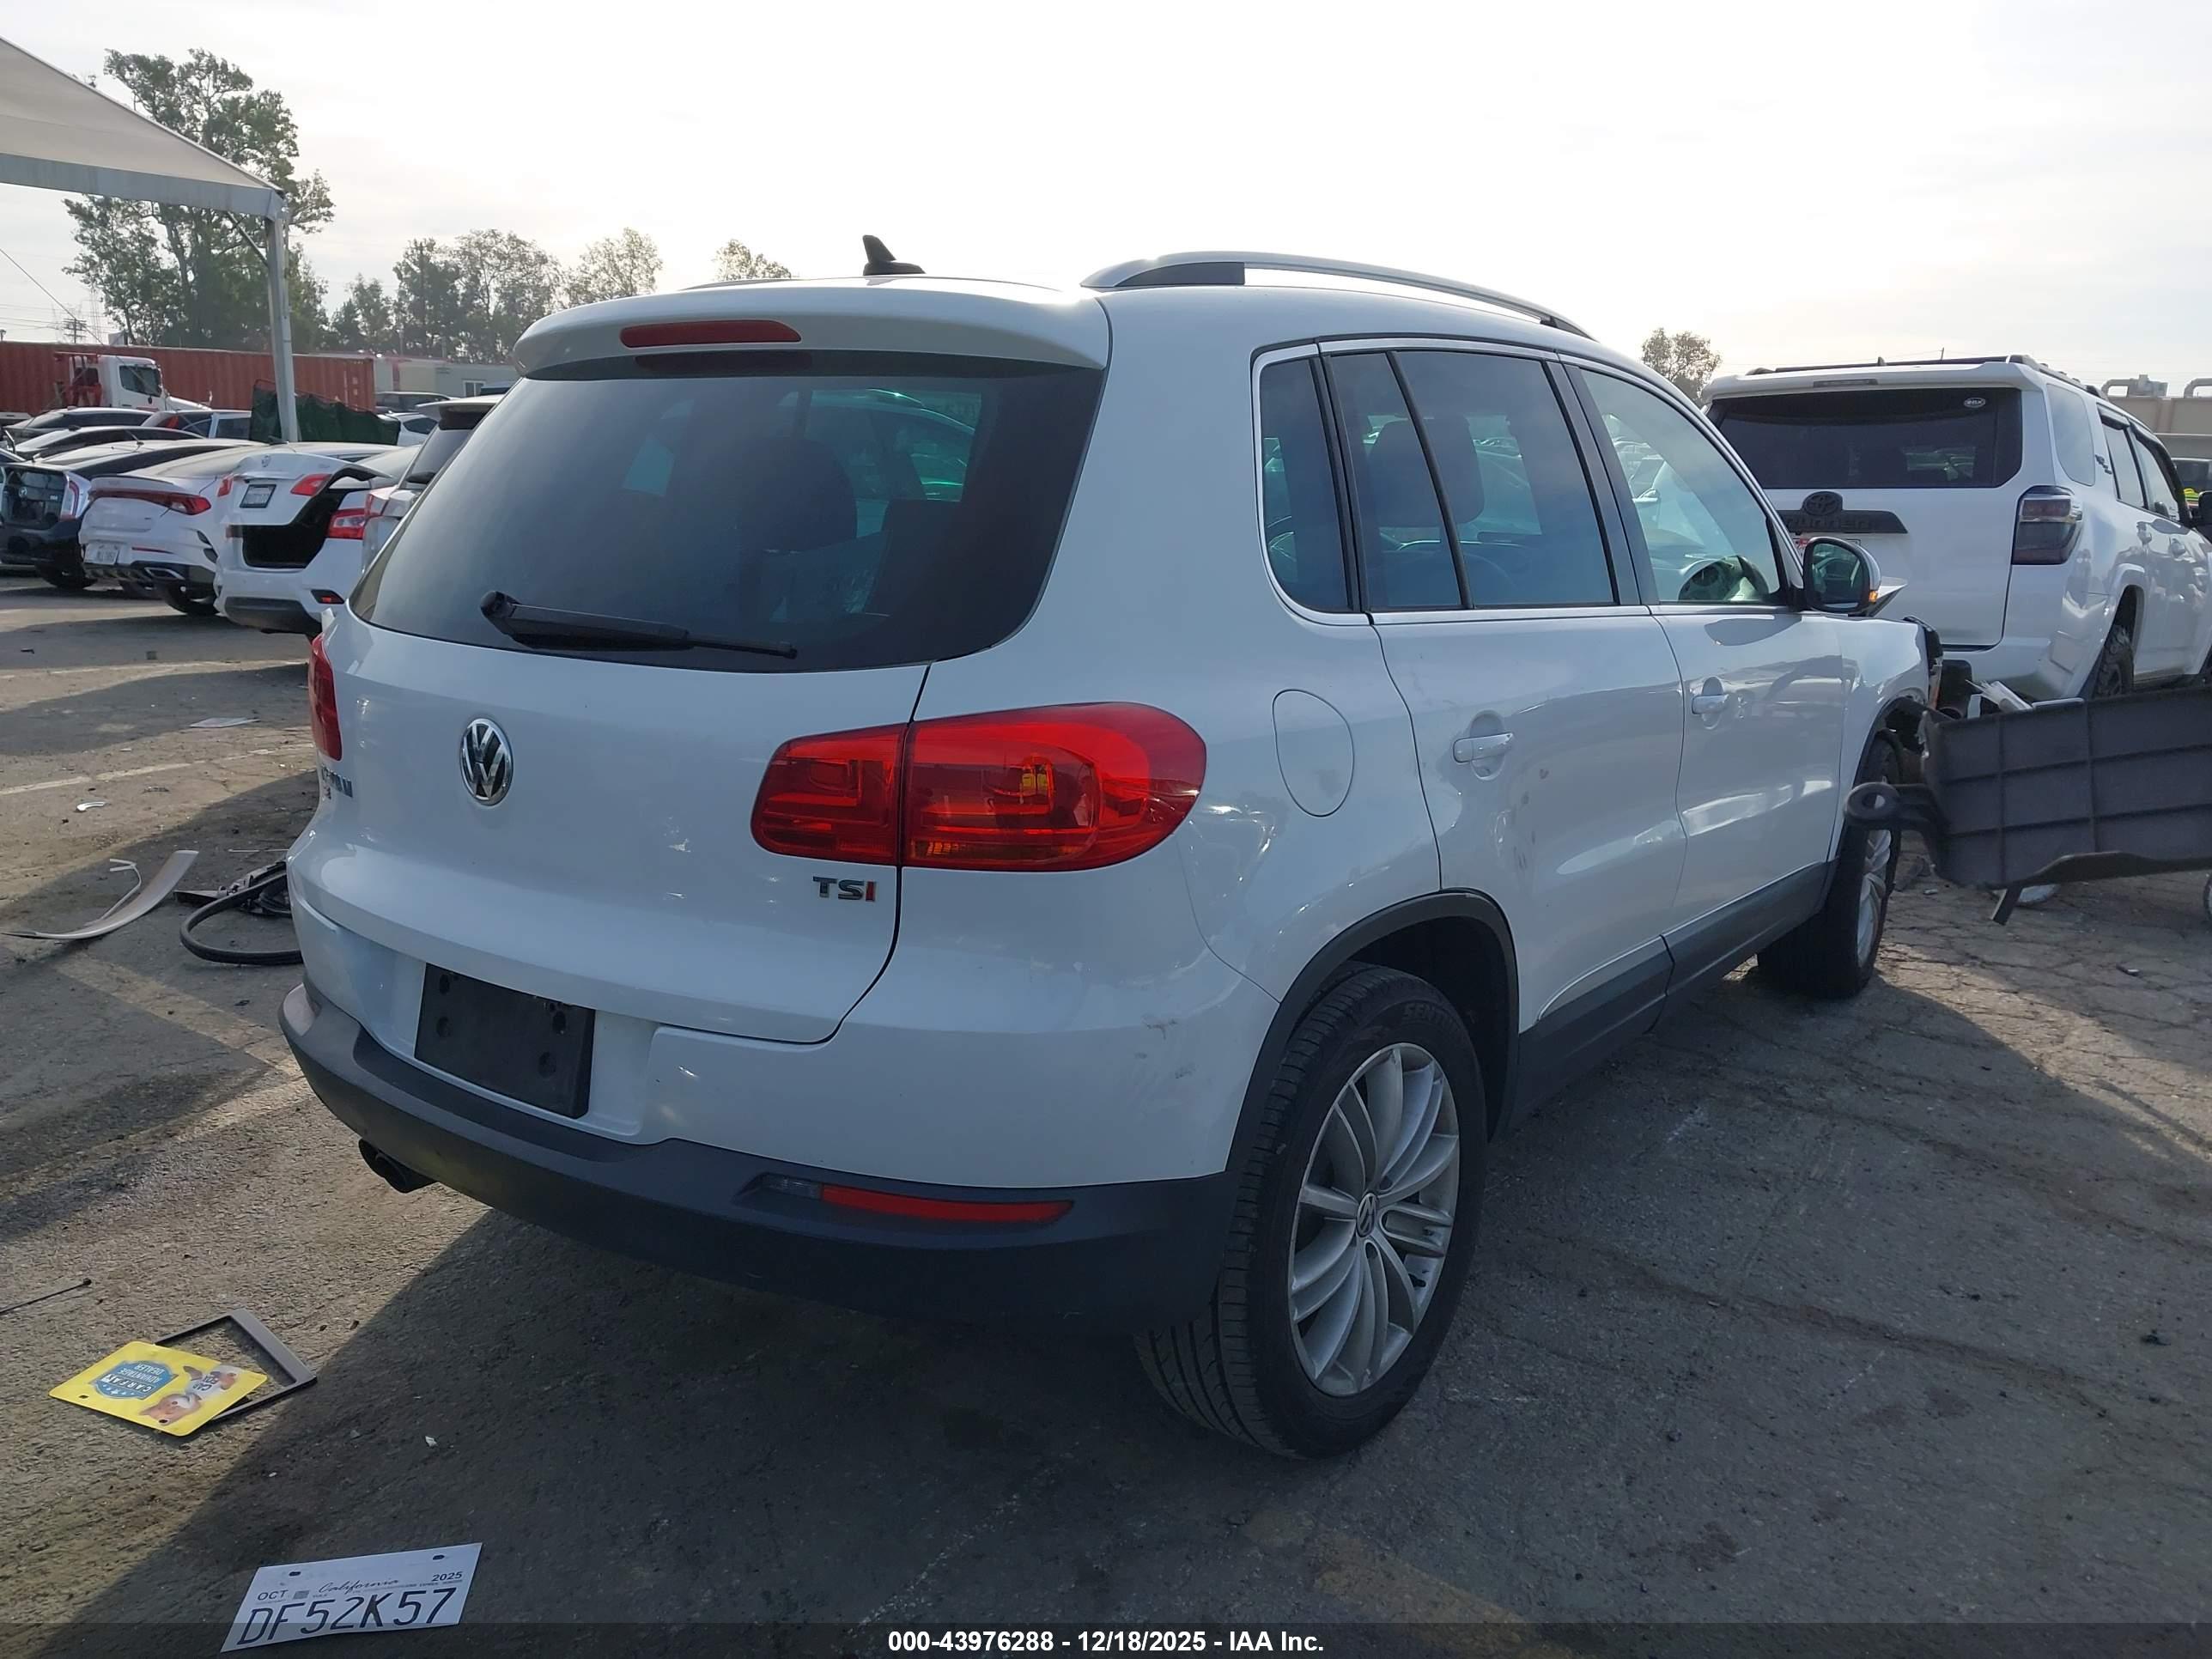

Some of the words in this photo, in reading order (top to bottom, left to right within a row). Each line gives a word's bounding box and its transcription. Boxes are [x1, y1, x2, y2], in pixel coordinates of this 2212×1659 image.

[813, 877, 876, 902] TSI
[134, 1363, 165, 1375] DEALER
[432, 1571, 463, 1582] 2025
[319, 1578, 399, 1595] California
[258, 1589, 288, 1601] OCT
[237, 1588, 457, 1645] DF52K57
